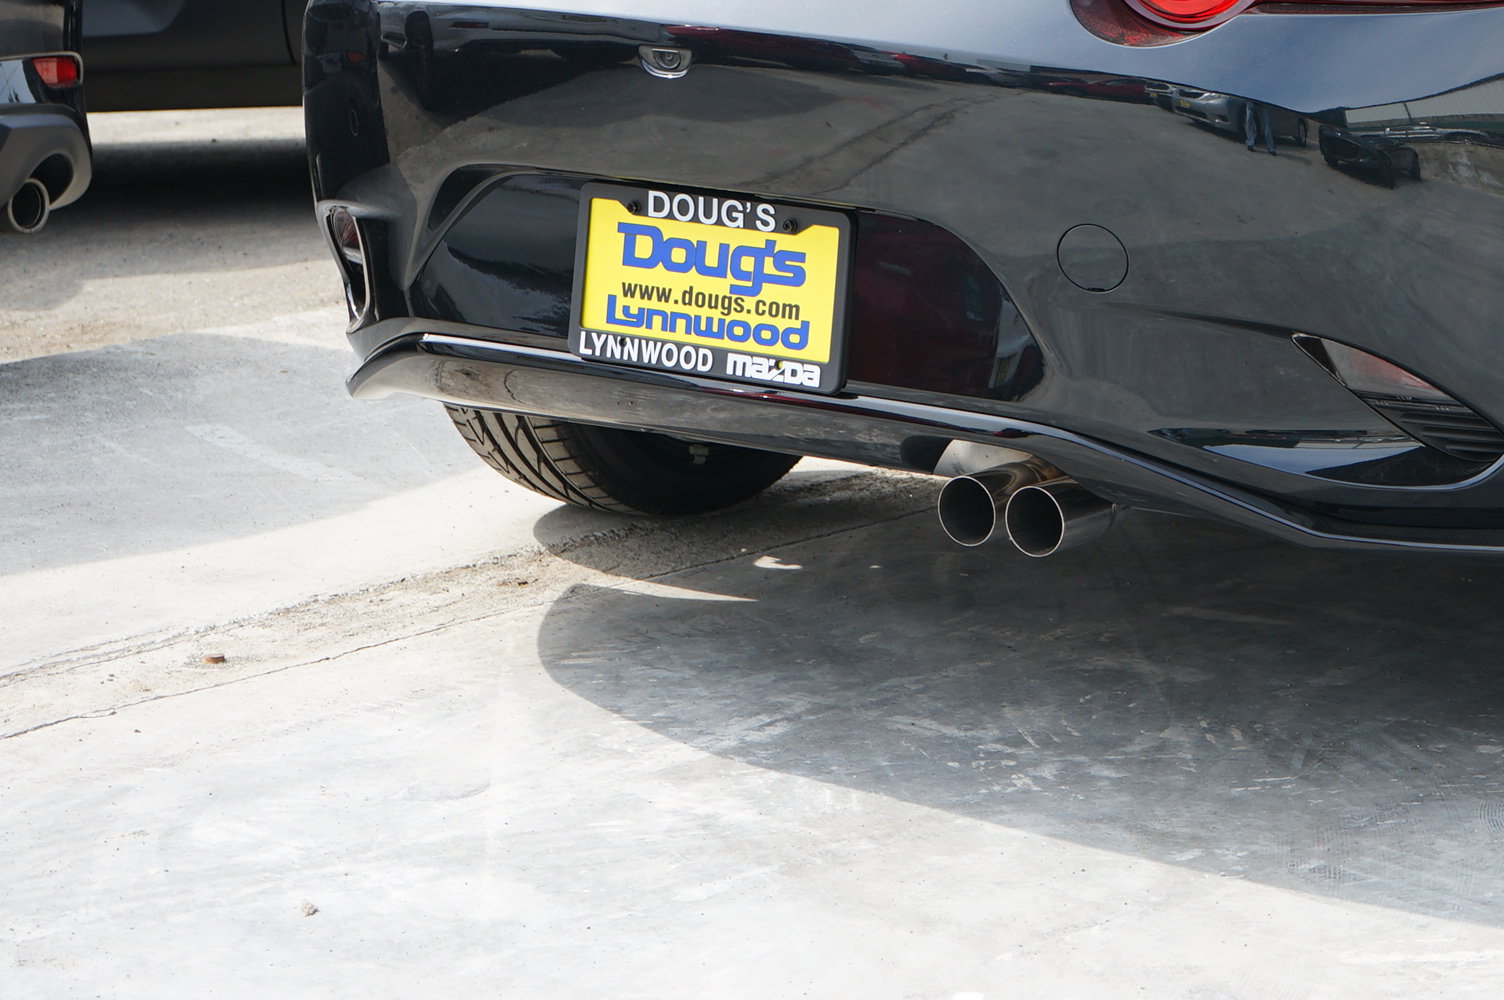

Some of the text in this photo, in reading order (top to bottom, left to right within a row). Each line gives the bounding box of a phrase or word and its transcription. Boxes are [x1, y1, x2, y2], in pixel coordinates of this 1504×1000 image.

[647, 190, 776, 232] DOUG'S
[617, 221, 807, 298] Doug's
[605, 294, 811, 351] Lynnwood
[621, 281, 801, 321] www.dougs.com
[579, 330, 713, 373] LYNNWOOD
